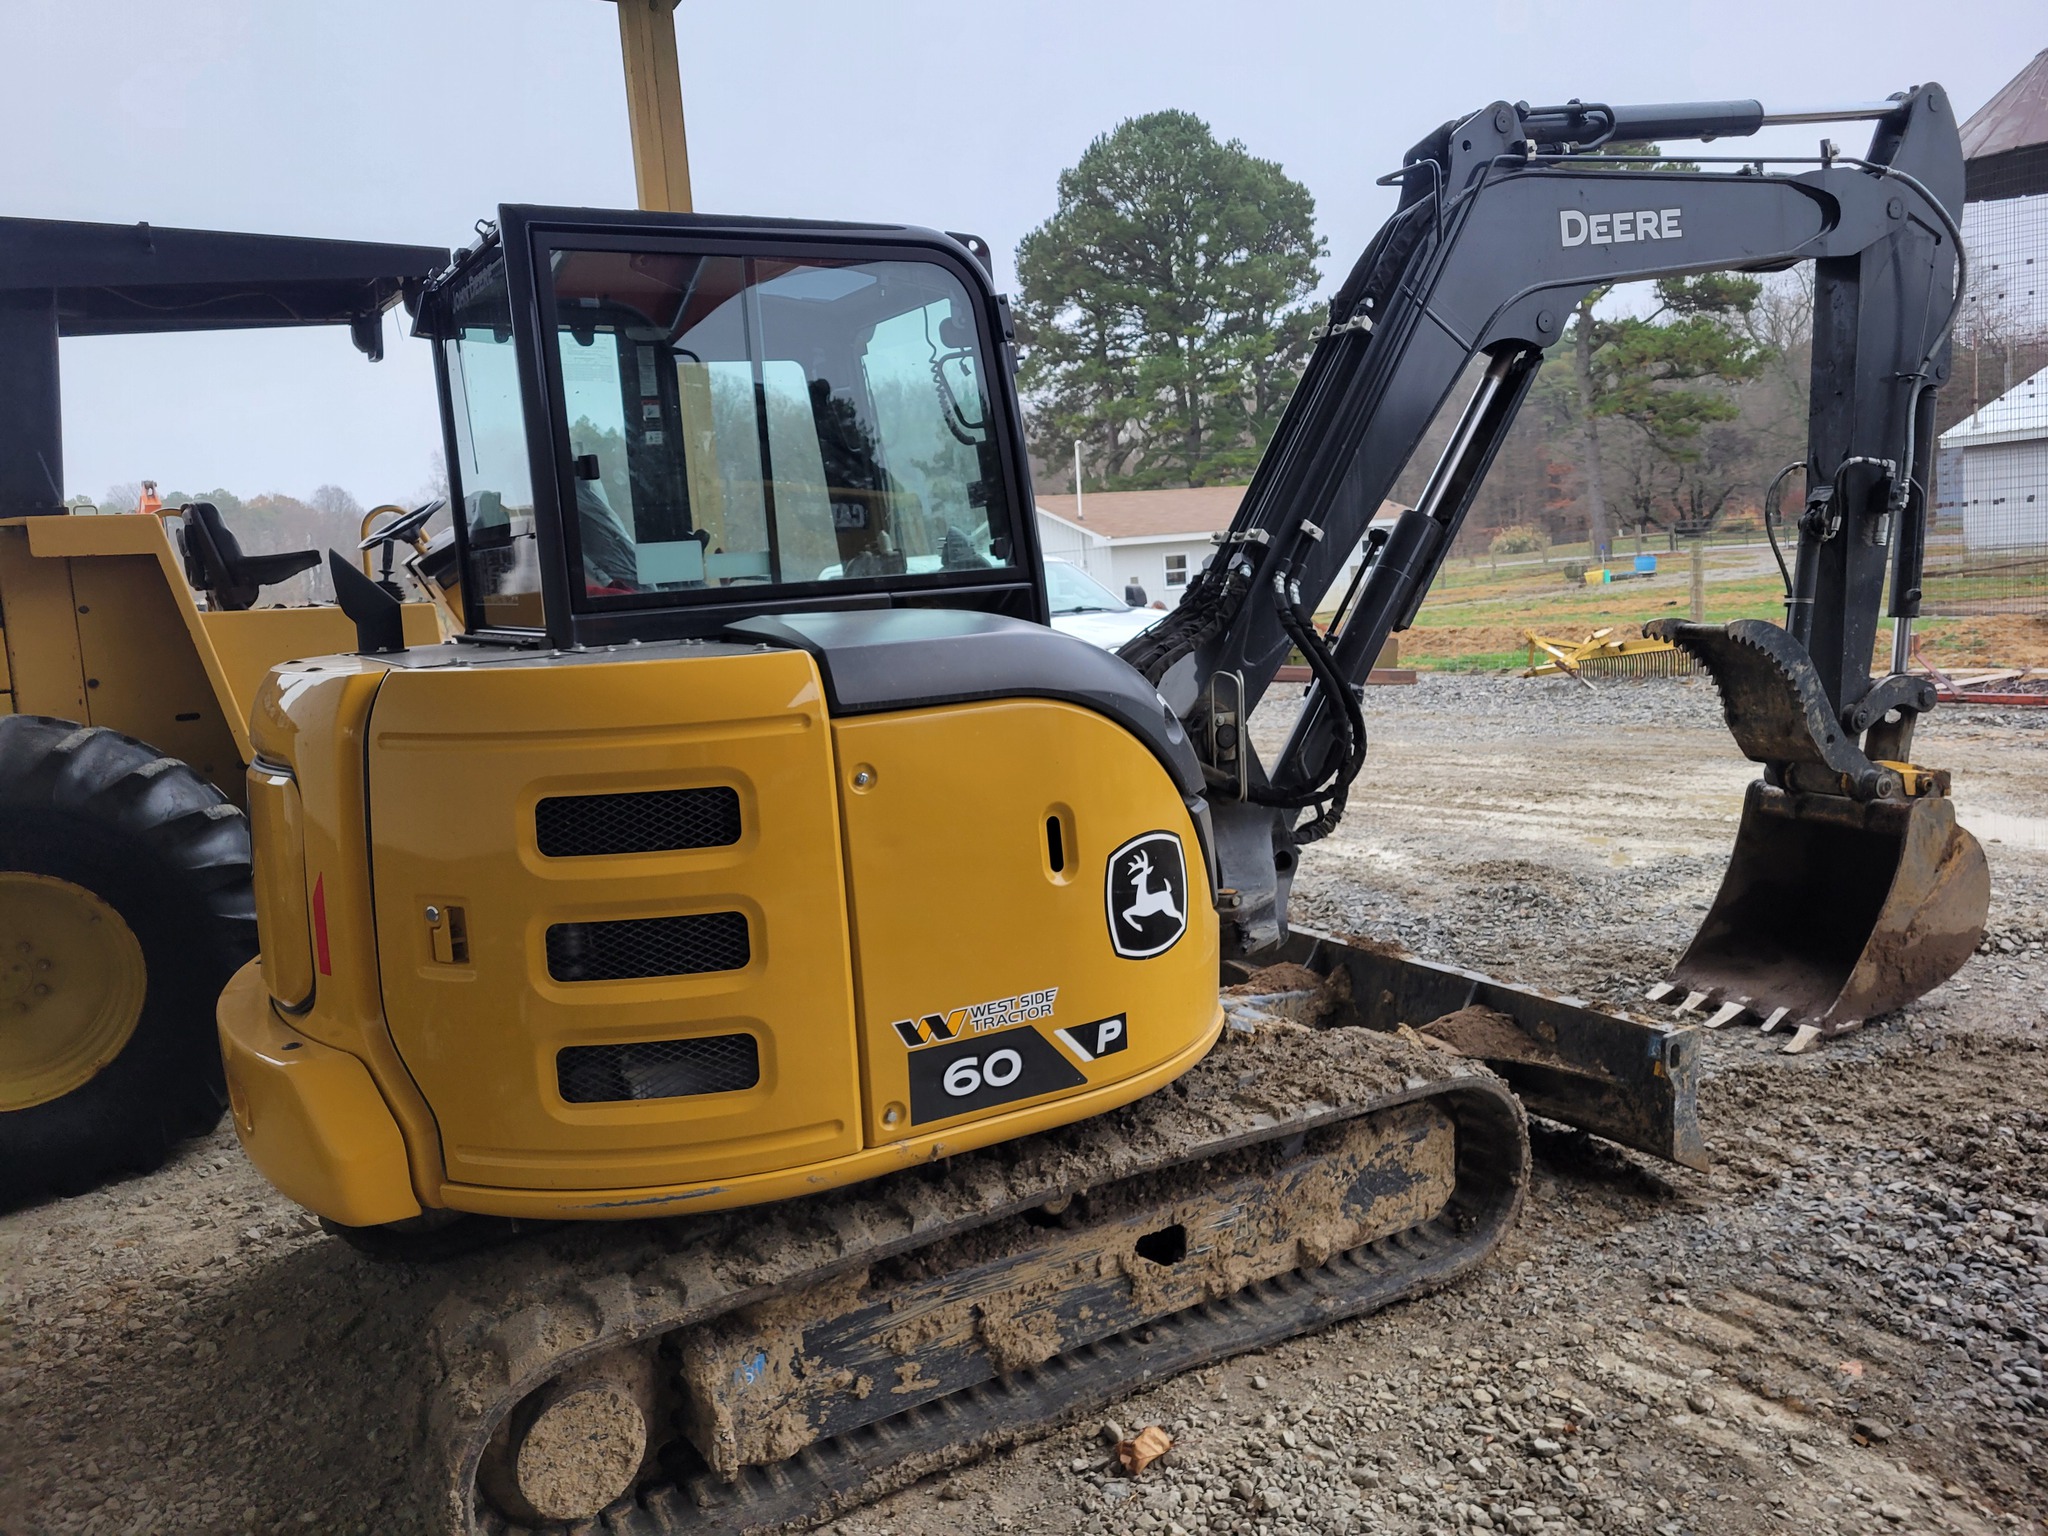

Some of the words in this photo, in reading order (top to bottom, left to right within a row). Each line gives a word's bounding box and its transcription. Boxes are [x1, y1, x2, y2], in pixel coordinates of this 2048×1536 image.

[1560, 208, 1683, 247] DEERE
[970, 998, 1016, 1018] WEST
[1020, 989, 1057, 1008] SIDE
[971, 1004, 1052, 1031] TRACTOR
[943, 1049, 1022, 1096] 60
